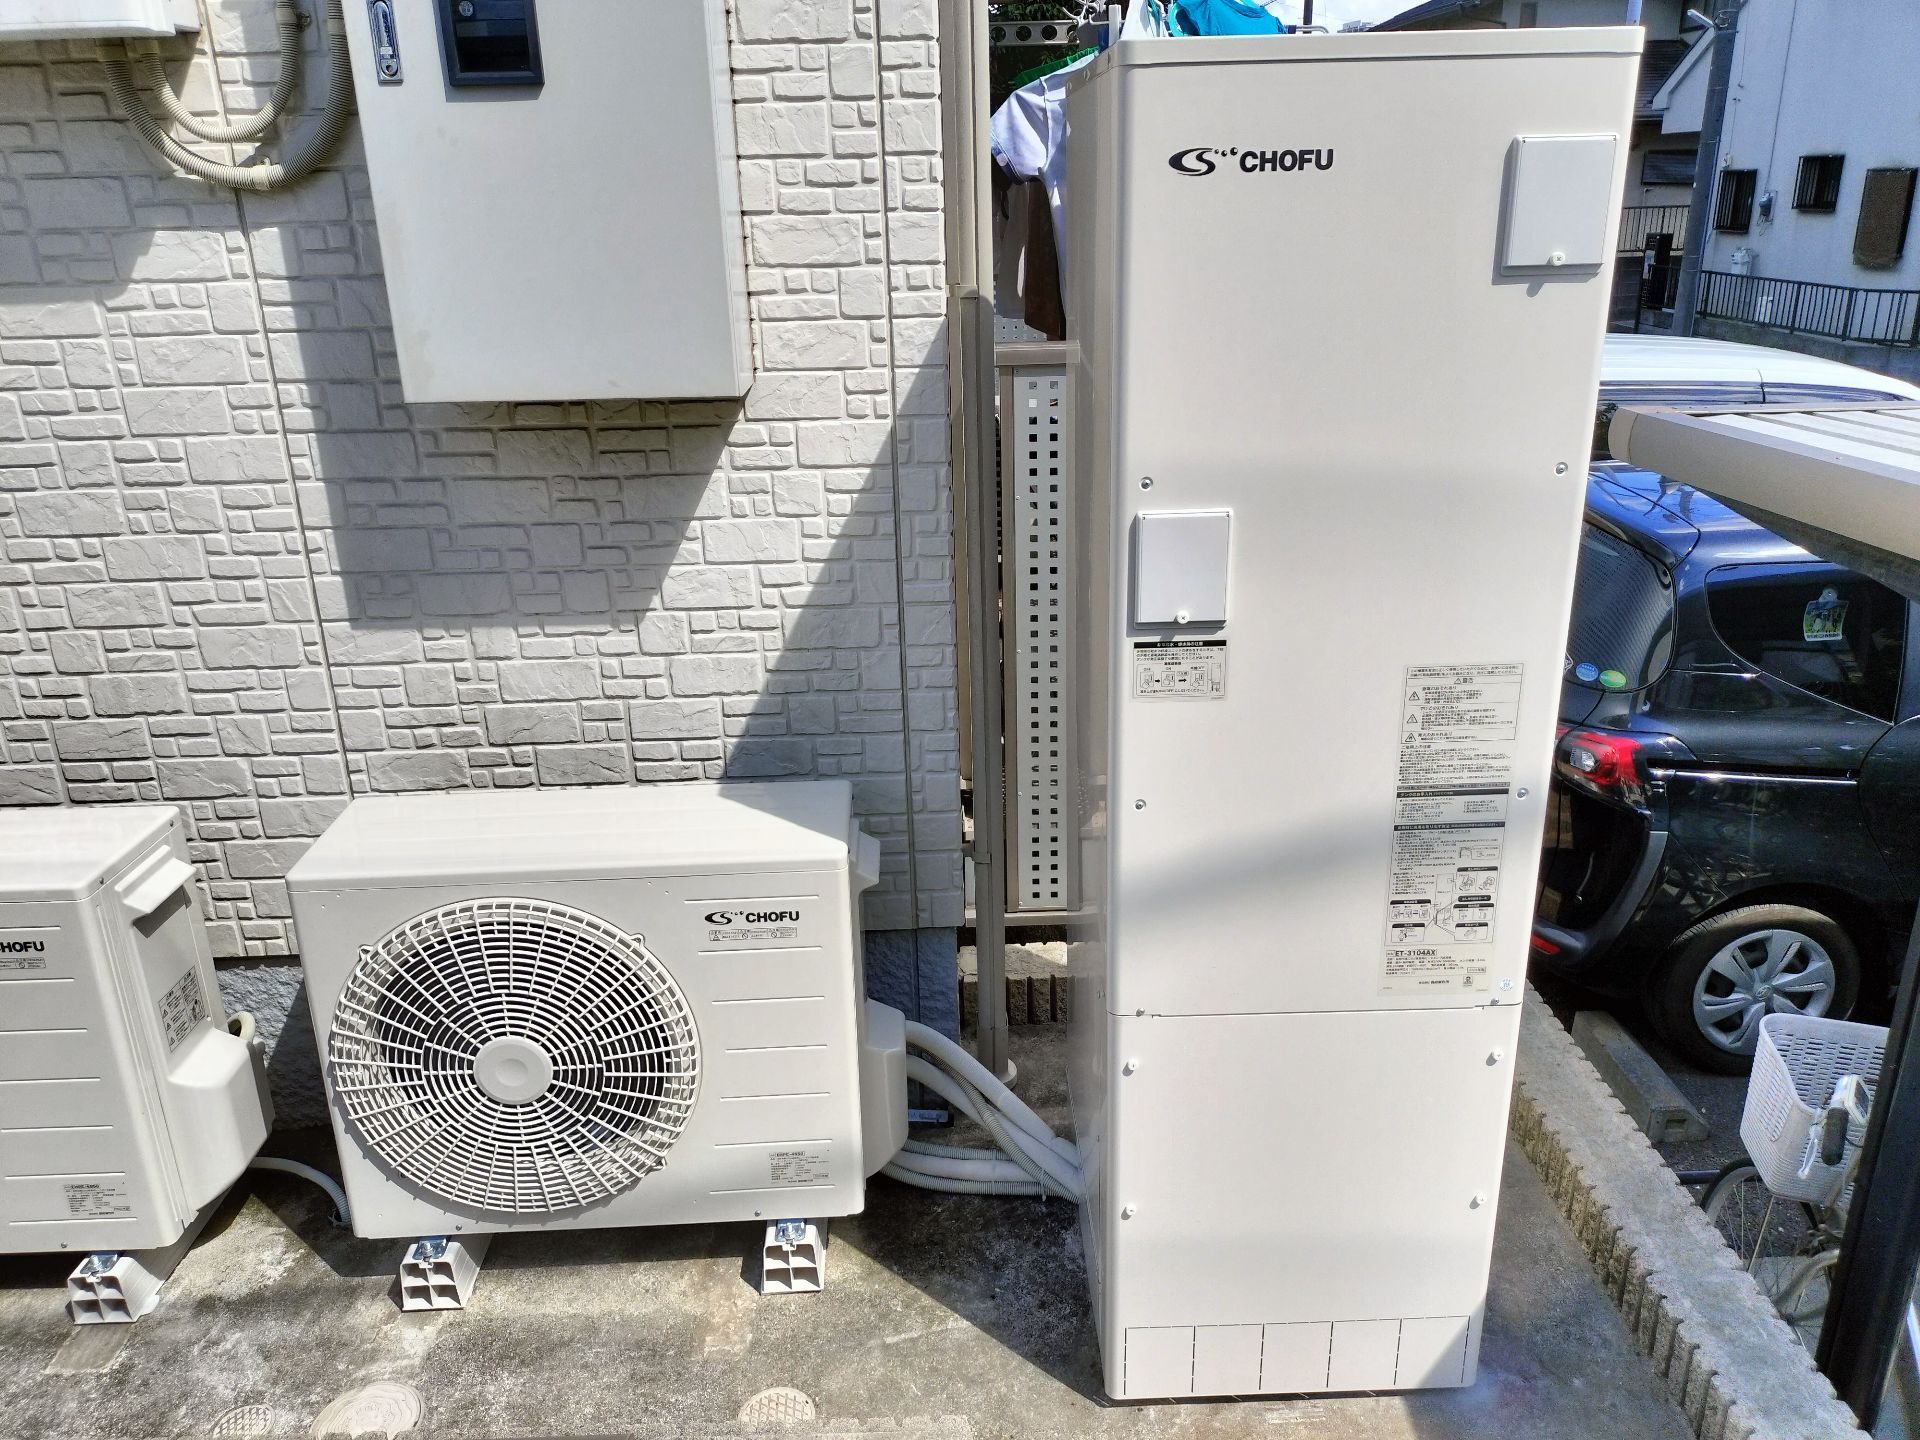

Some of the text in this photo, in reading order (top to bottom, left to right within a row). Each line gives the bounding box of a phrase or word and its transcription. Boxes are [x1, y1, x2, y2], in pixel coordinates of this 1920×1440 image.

[1239, 148, 1335, 173] CHOFU
[745, 910, 800, 923] CHOFU
[0, 940, 45, 953] HOFU
[1395, 949, 1436, 957] ET-3104AX
